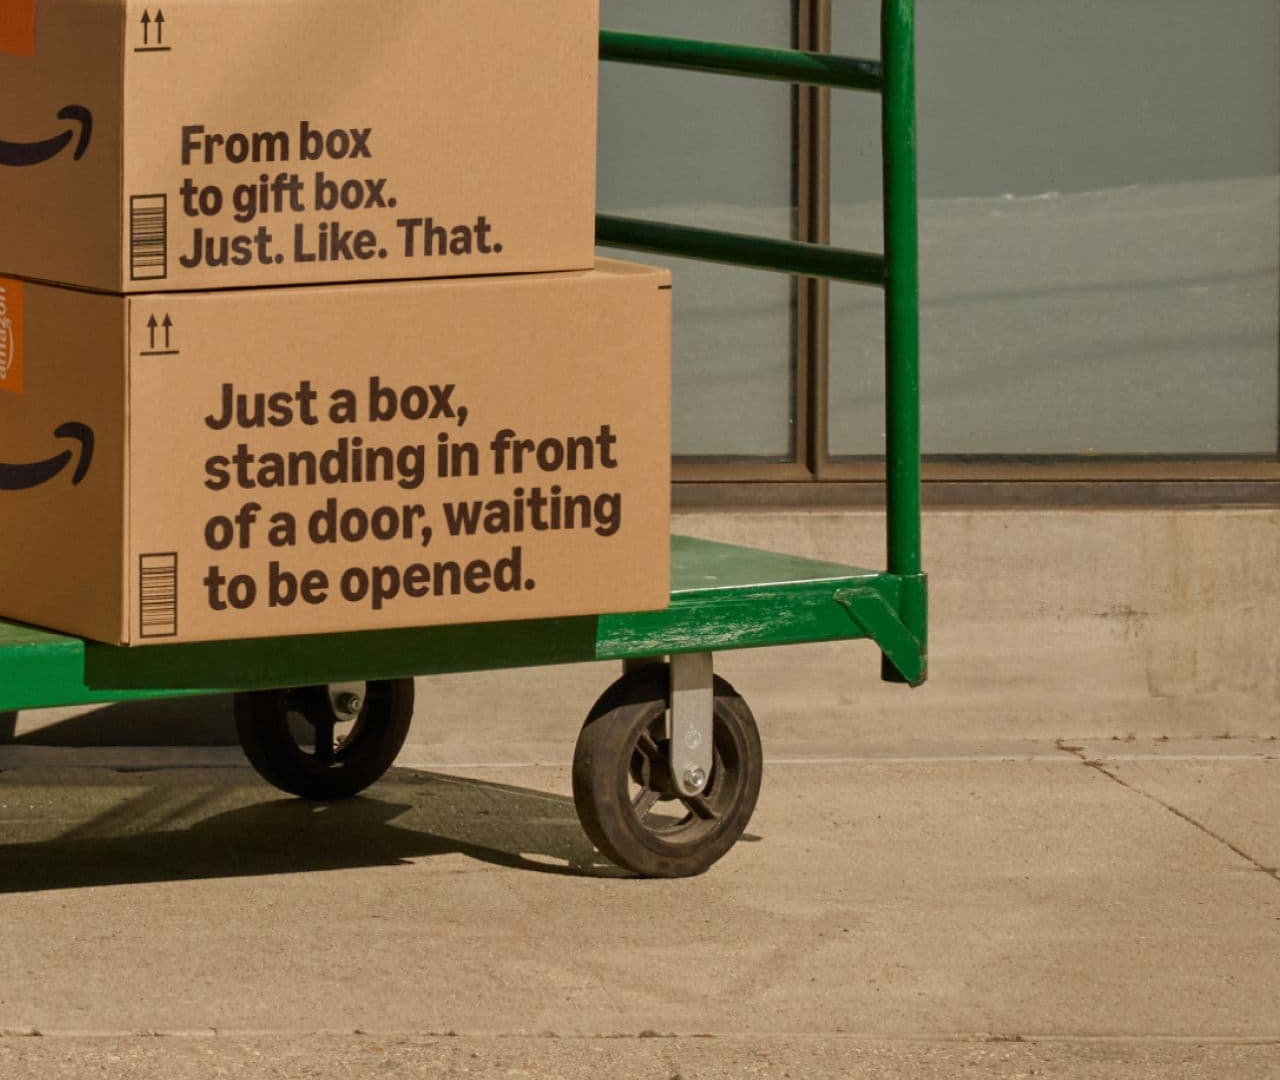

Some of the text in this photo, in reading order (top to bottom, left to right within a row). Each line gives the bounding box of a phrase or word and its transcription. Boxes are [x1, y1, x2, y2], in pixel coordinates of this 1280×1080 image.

[181, 120, 372, 166] From box
[179, 171, 397, 223] to gift box.
[179, 215, 503, 269] Just. Like. That.
[204, 375, 468, 431] Just a box,
[204, 424, 618, 491] standing in front
[204, 487, 622, 551] of a door, waiting
[203, 545, 536, 611] to be opened.
